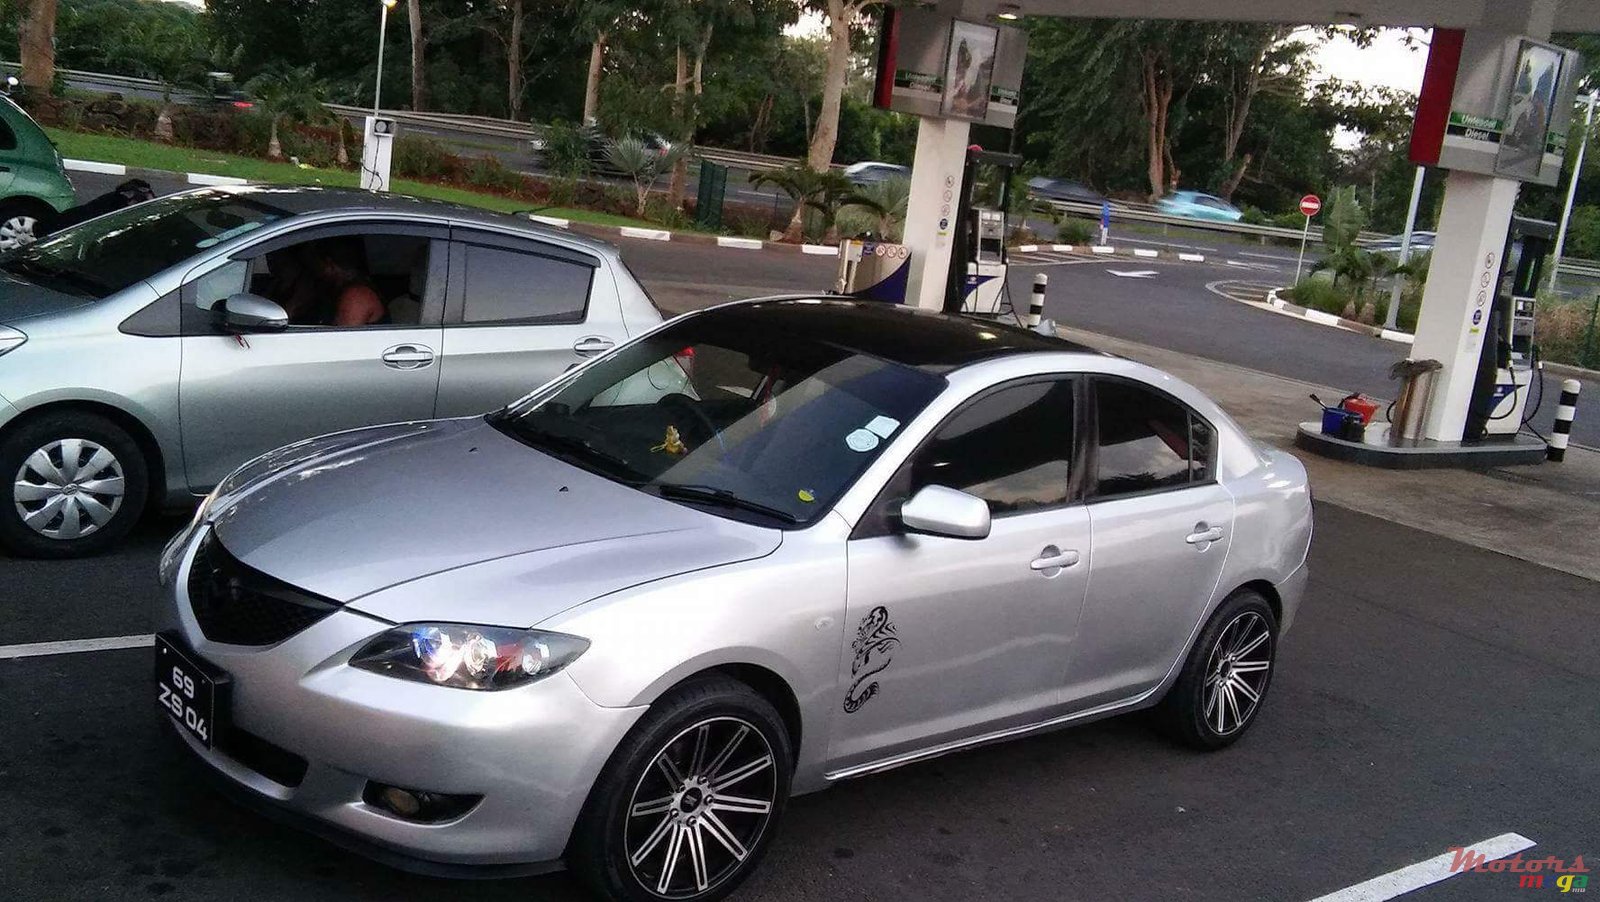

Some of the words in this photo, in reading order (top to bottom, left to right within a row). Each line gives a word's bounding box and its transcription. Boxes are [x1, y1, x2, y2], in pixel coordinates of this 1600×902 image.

[1465, 128, 1490, 141] Diesel
[172, 666, 195, 699] 69
[158, 682, 183, 718] ZS
[185, 706, 208, 741] 04
